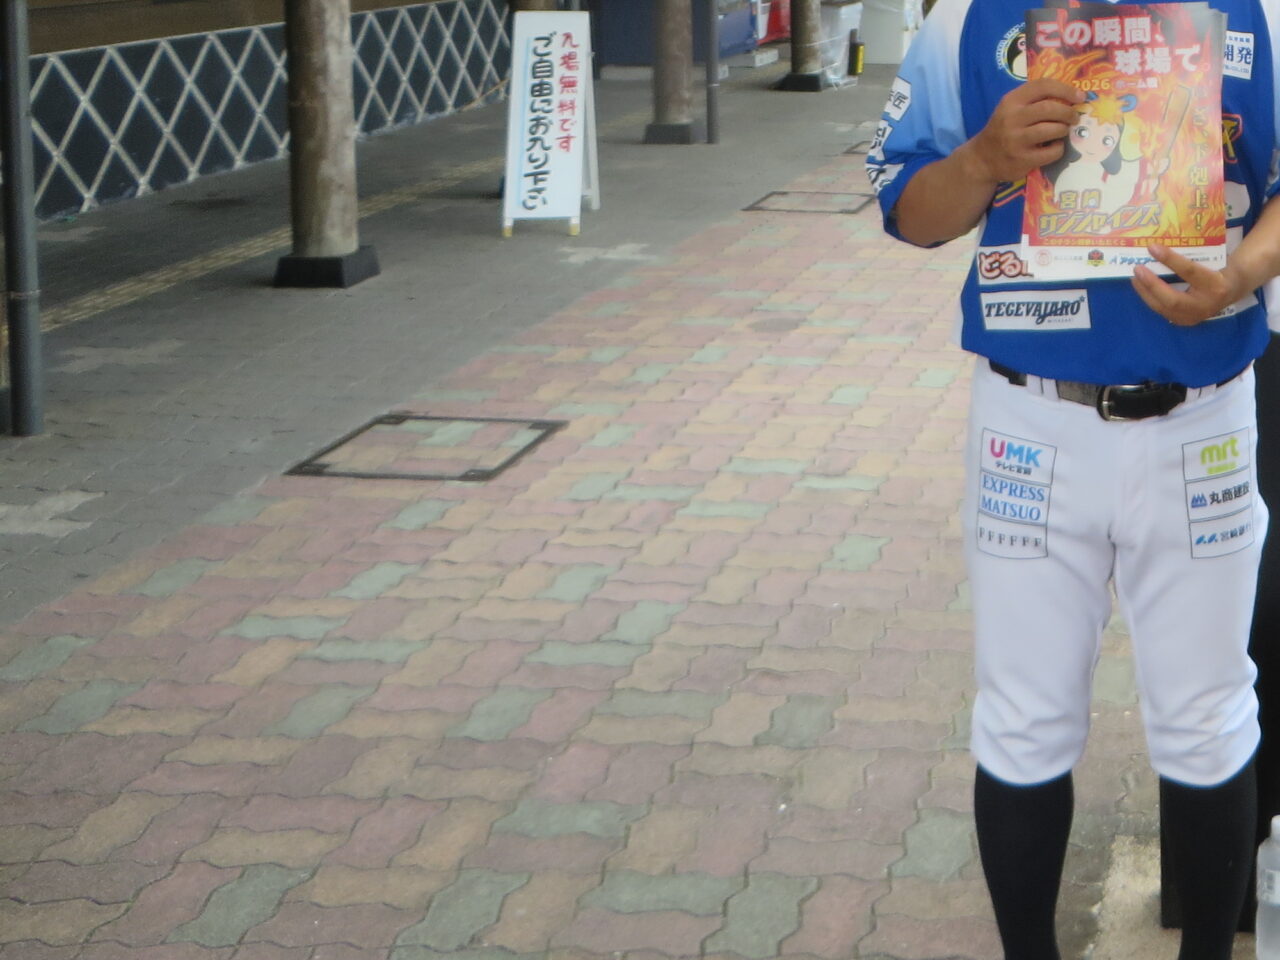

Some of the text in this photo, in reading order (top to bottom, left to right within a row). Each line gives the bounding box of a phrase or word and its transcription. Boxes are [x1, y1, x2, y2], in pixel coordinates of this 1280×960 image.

[1036, 16, 1164, 48] この瞬間、
[555, 31, 579, 153] 入場無料です
[990, 437, 1043, 467] UMK
[1200, 436, 1239, 465] mrt
[982, 474, 1045, 502] EXPRESS
[981, 495, 1041, 521] MATSUO
